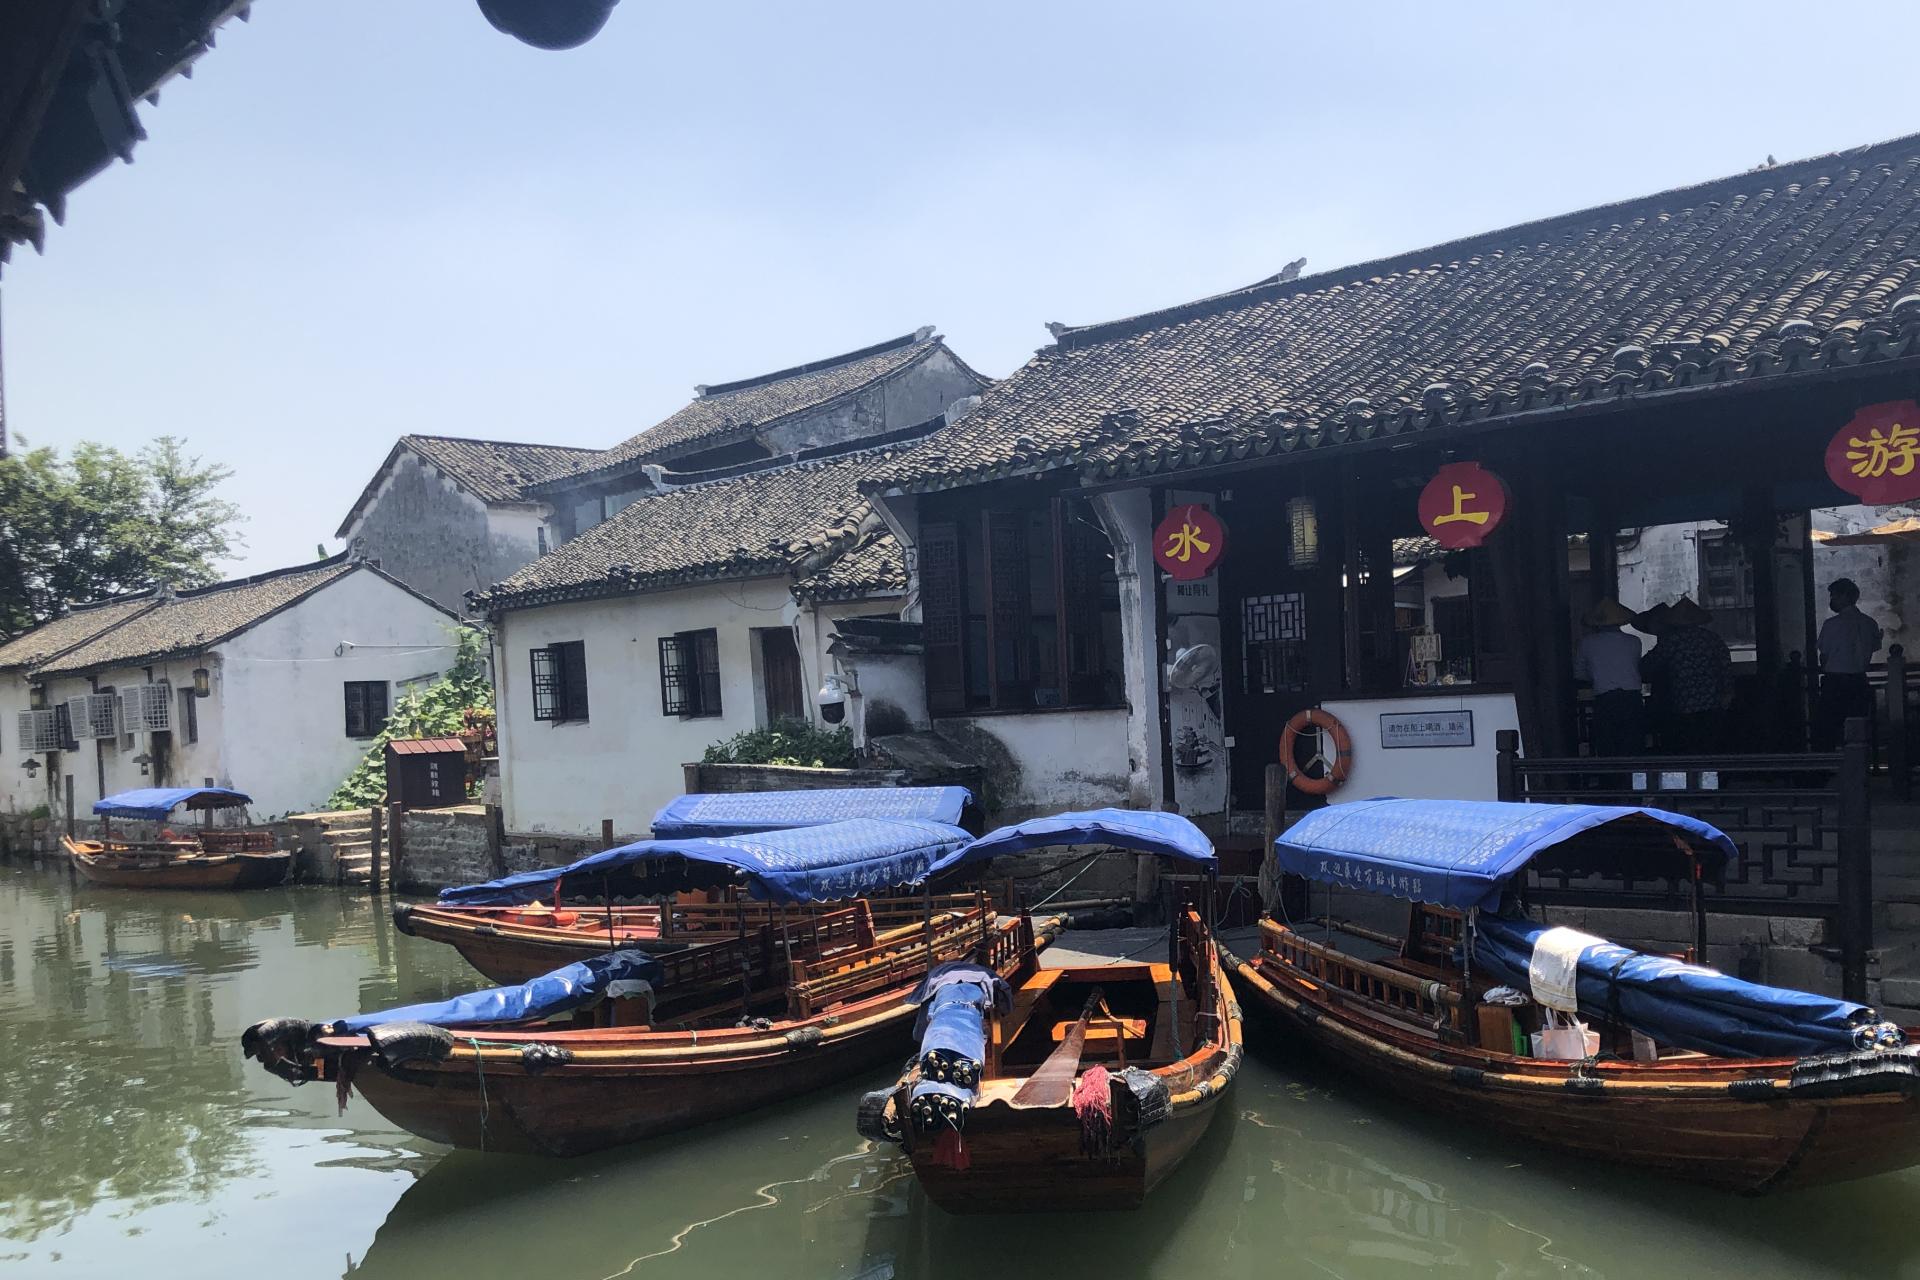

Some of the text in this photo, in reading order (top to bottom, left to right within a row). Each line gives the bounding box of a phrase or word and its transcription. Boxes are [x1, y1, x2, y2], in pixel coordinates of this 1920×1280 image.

[1846, 423, 1920, 478] 游
[1433, 485, 1489, 526] 上
[1165, 523, 1210, 561] 水
